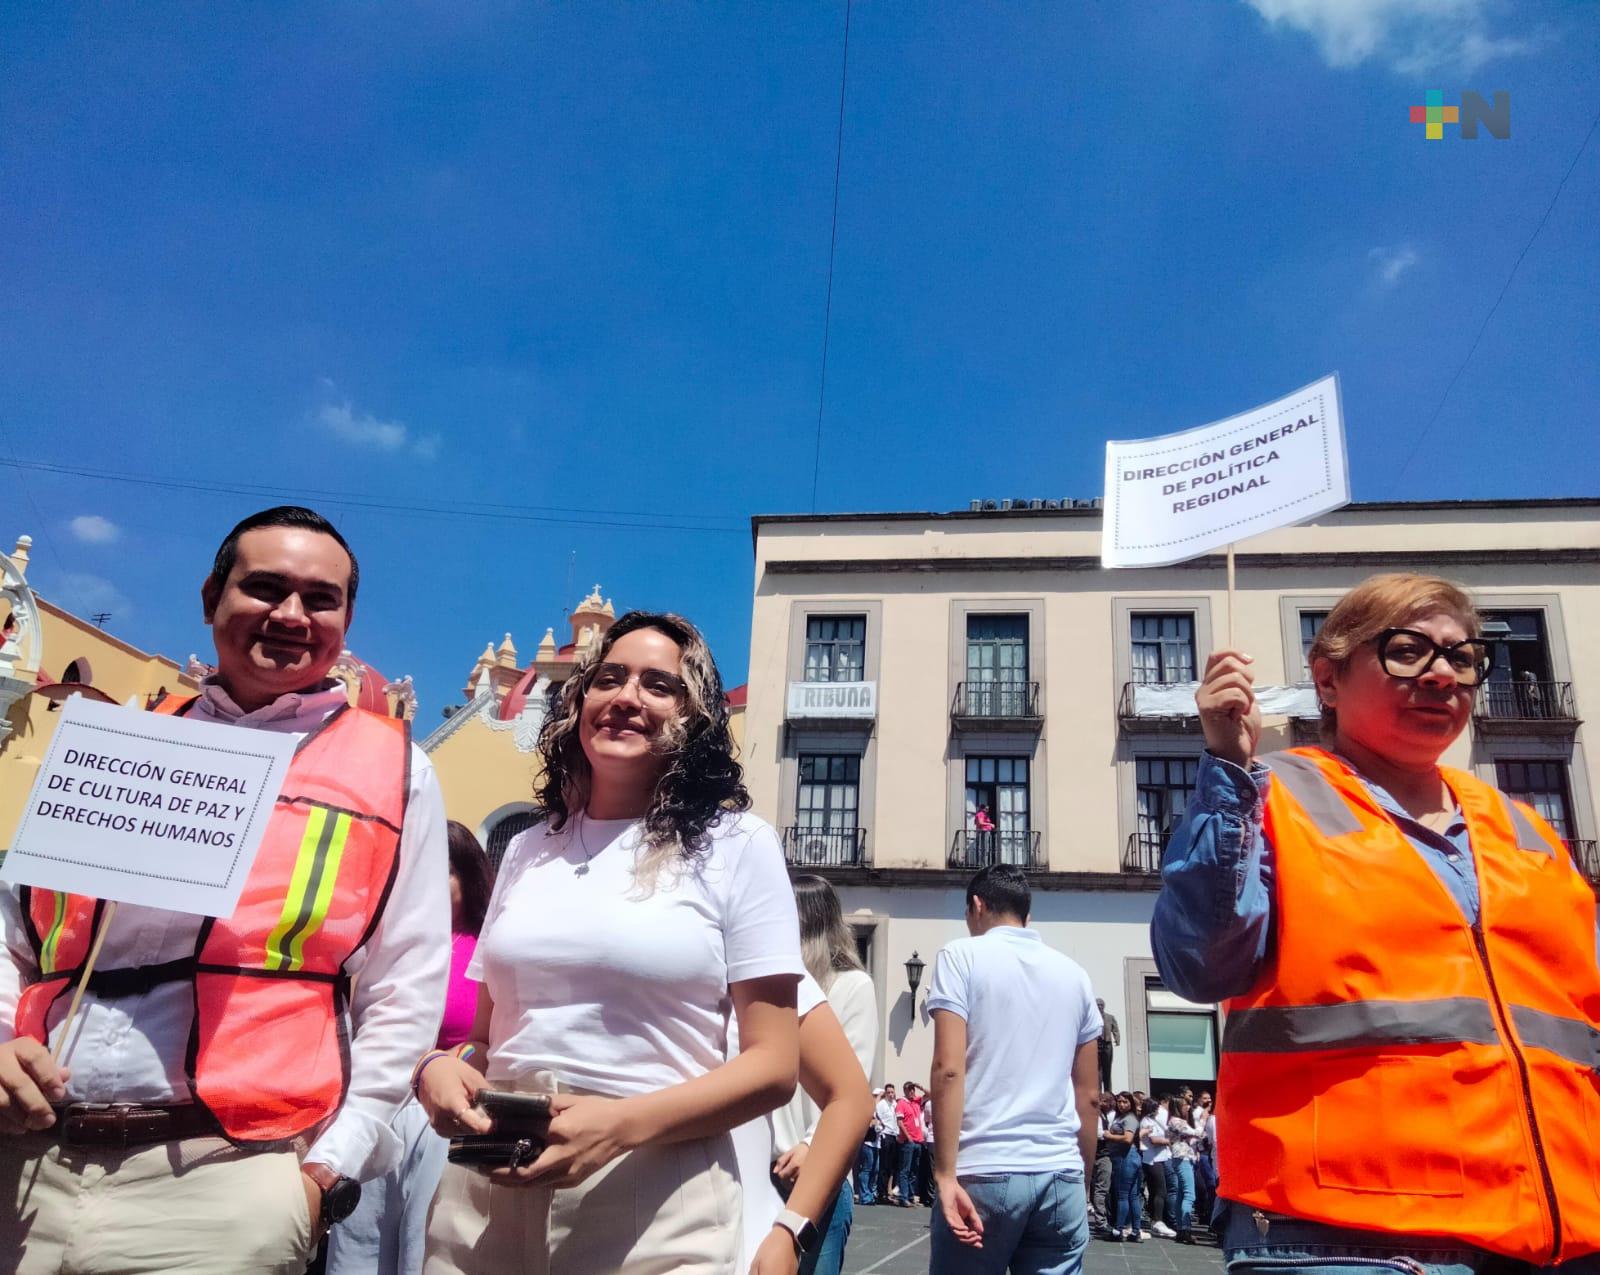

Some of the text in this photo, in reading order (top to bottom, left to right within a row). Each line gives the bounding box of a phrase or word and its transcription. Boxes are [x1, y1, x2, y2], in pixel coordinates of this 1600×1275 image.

[1123, 413, 1320, 482] DIRECCIÓN GENERAL
[1162, 450, 1281, 496] DE POLÍTICA
[1172, 474, 1271, 514] REGIONAL
[63, 748, 249, 795] DIRECCIÓN GENERAL
[47, 773, 246, 822] DE CULTURA DE PAZ Y
[36, 800, 236, 849] DERECHOS HUMANOS
